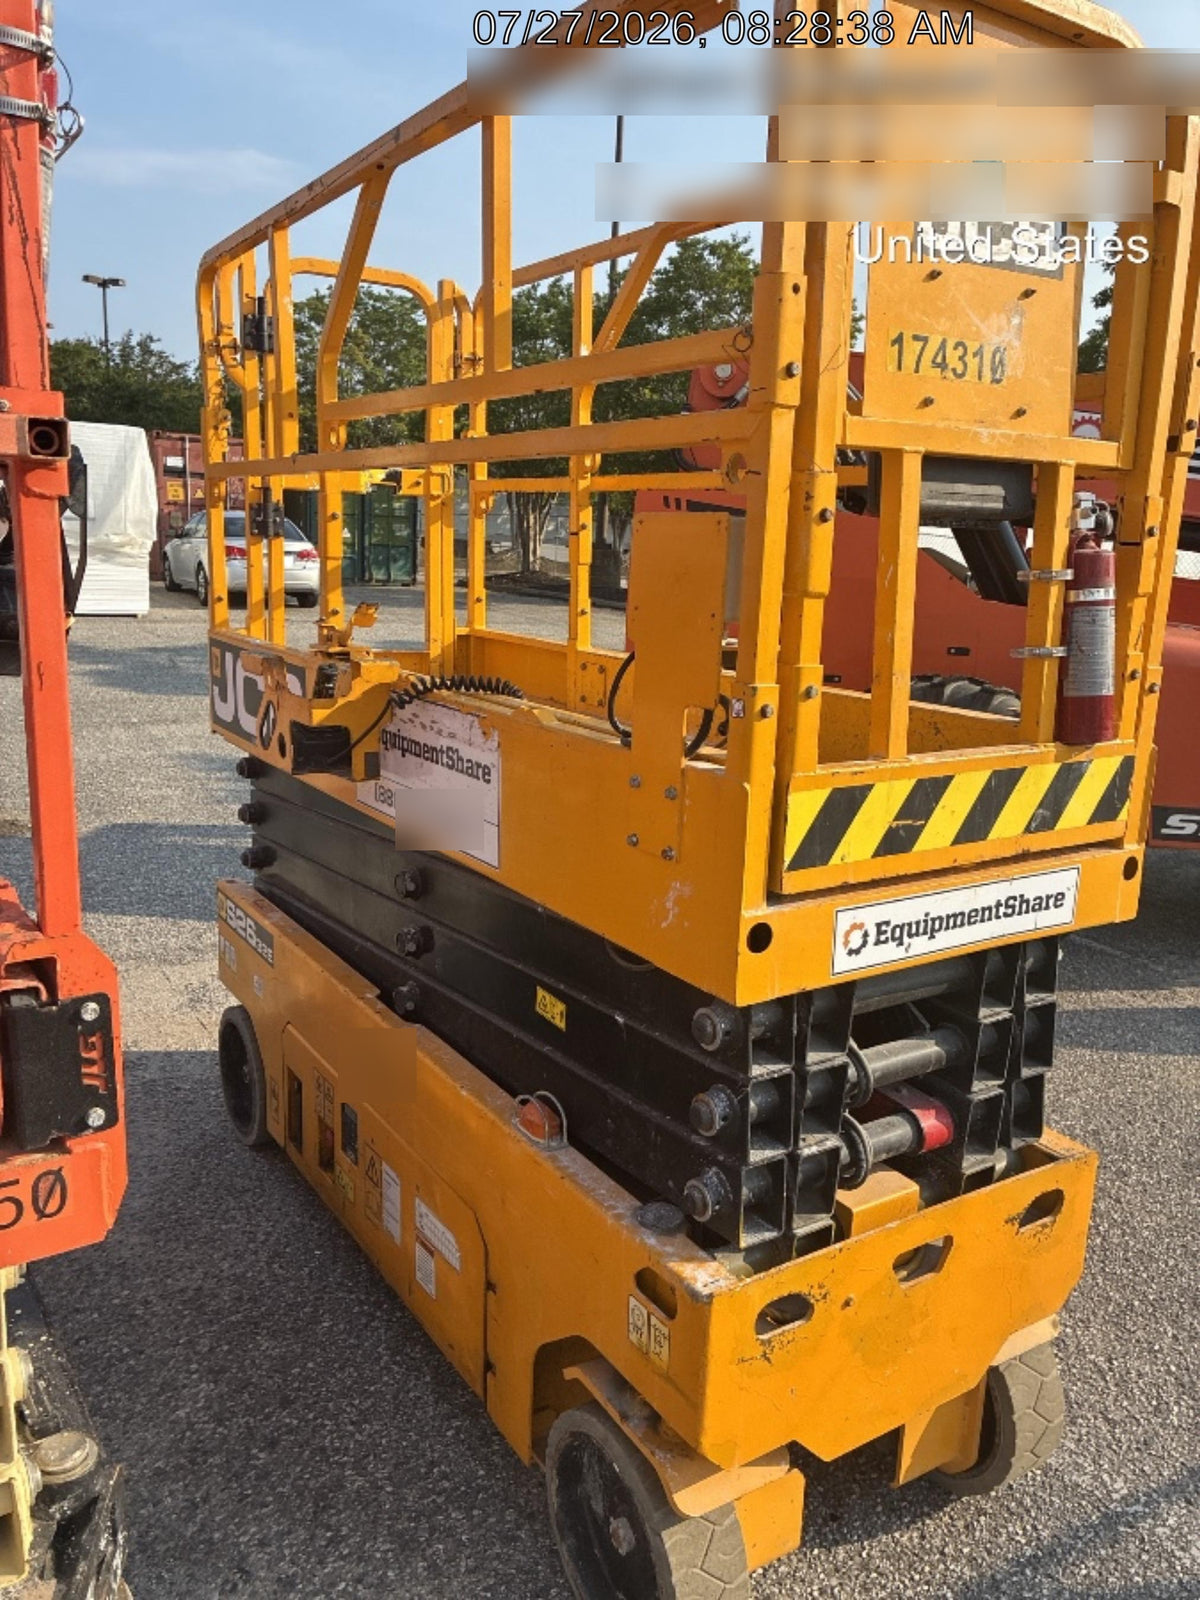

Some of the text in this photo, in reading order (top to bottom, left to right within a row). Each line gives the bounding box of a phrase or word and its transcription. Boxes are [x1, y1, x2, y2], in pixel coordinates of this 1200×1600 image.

[890, 331, 1007, 384] 174310
[380, 728, 492, 785] quipmentShare
[1161, 813, 1200, 836] S
[872, 891, 1066, 947] EquipmentShare
